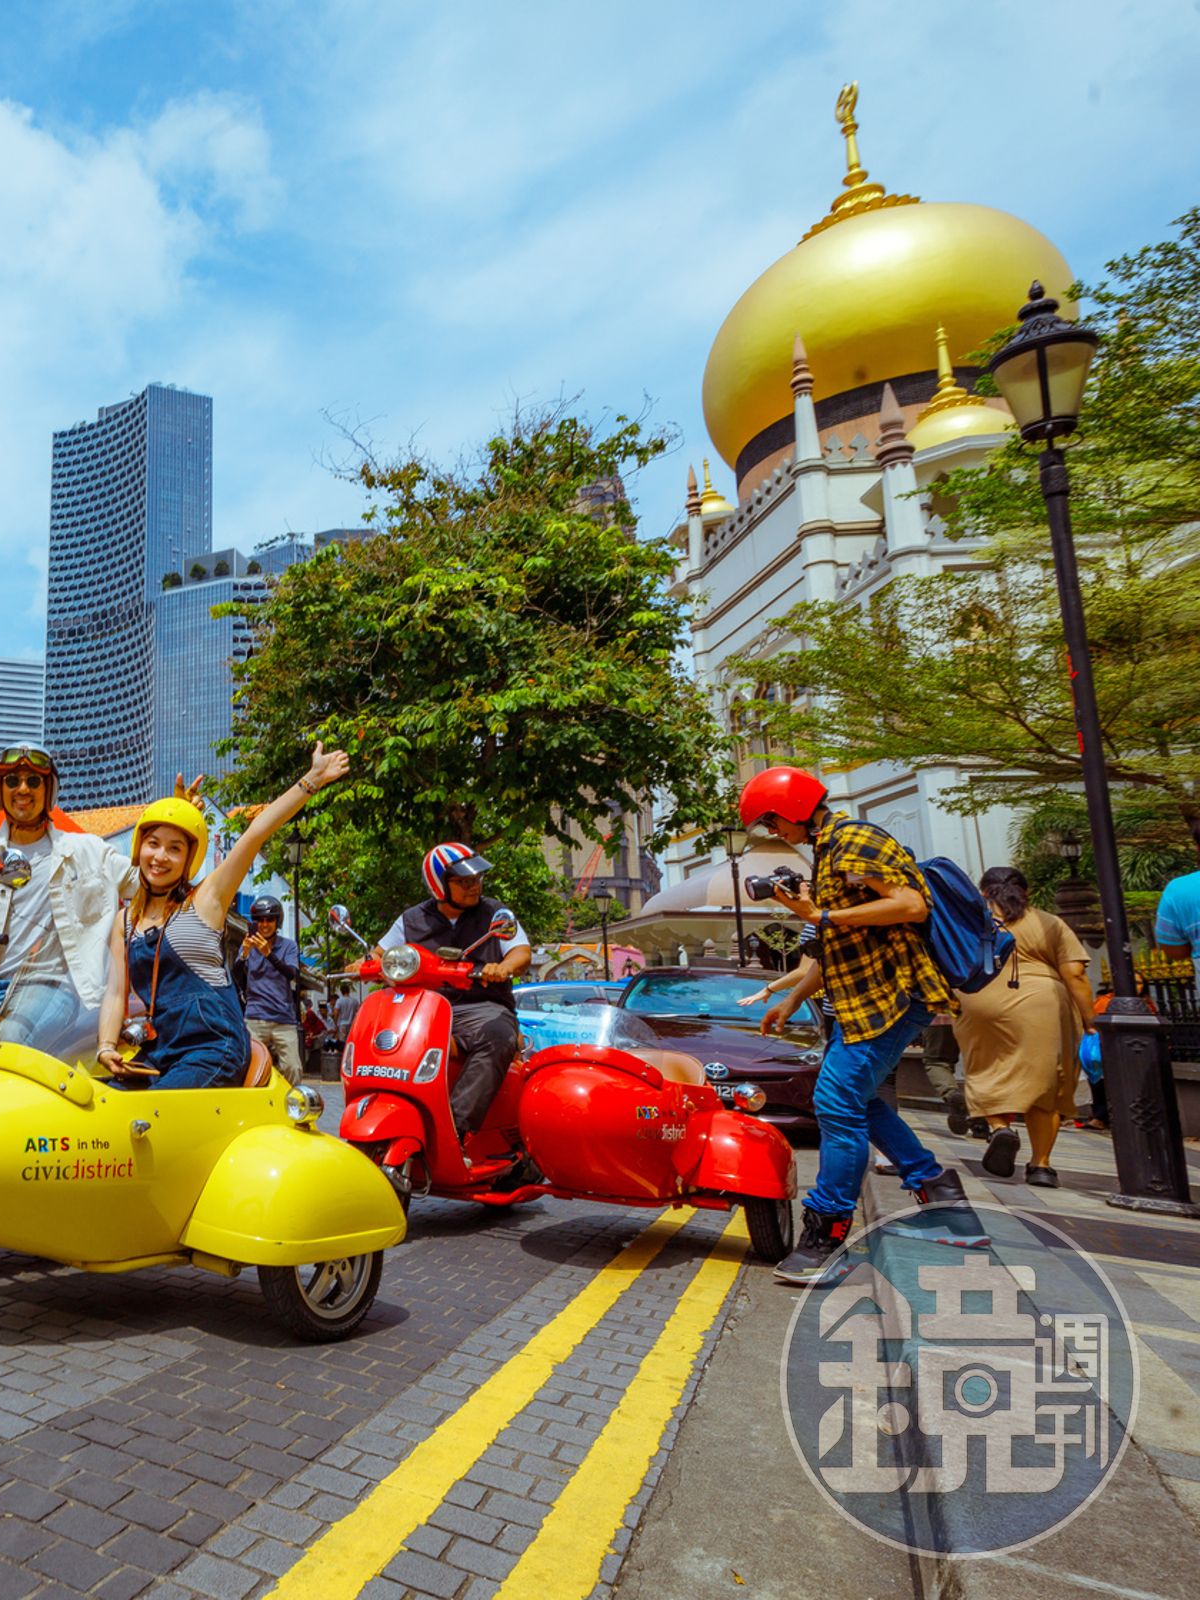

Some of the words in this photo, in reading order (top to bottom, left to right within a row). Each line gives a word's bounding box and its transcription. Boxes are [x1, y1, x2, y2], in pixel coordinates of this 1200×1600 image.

[24, 1136, 71, 1153] ARTS
[77, 1139, 88, 1150] in
[91, 1138, 110, 1150] the
